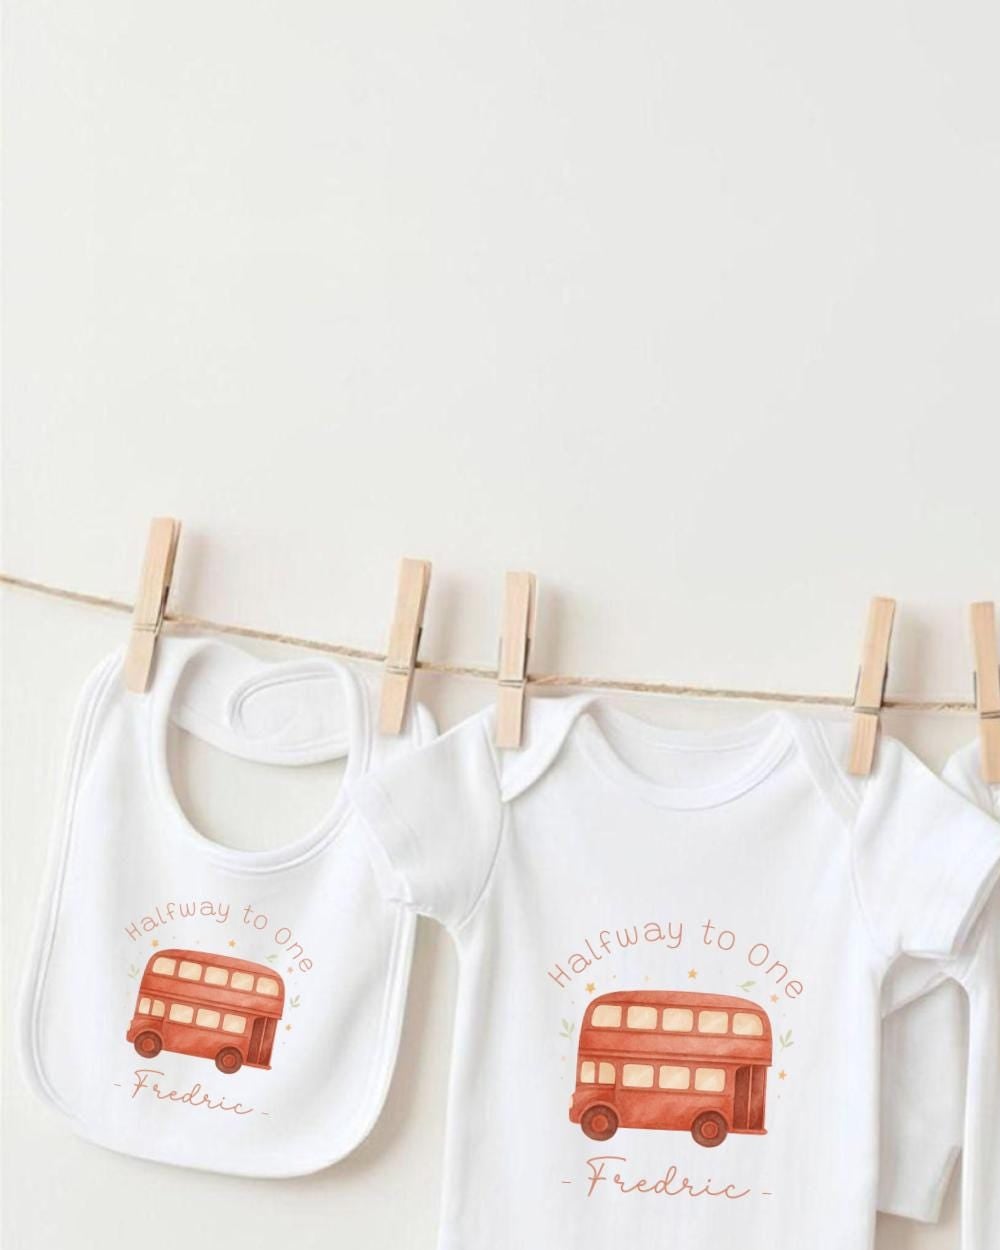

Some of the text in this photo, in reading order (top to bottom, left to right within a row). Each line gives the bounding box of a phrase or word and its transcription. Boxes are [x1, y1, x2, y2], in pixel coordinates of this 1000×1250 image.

[124, 899, 314, 973] Halfway to One
[547, 919, 805, 999] Halfway to One
[131, 1069, 254, 1115] Fredric
[585, 1154, 752, 1200] Fredric
